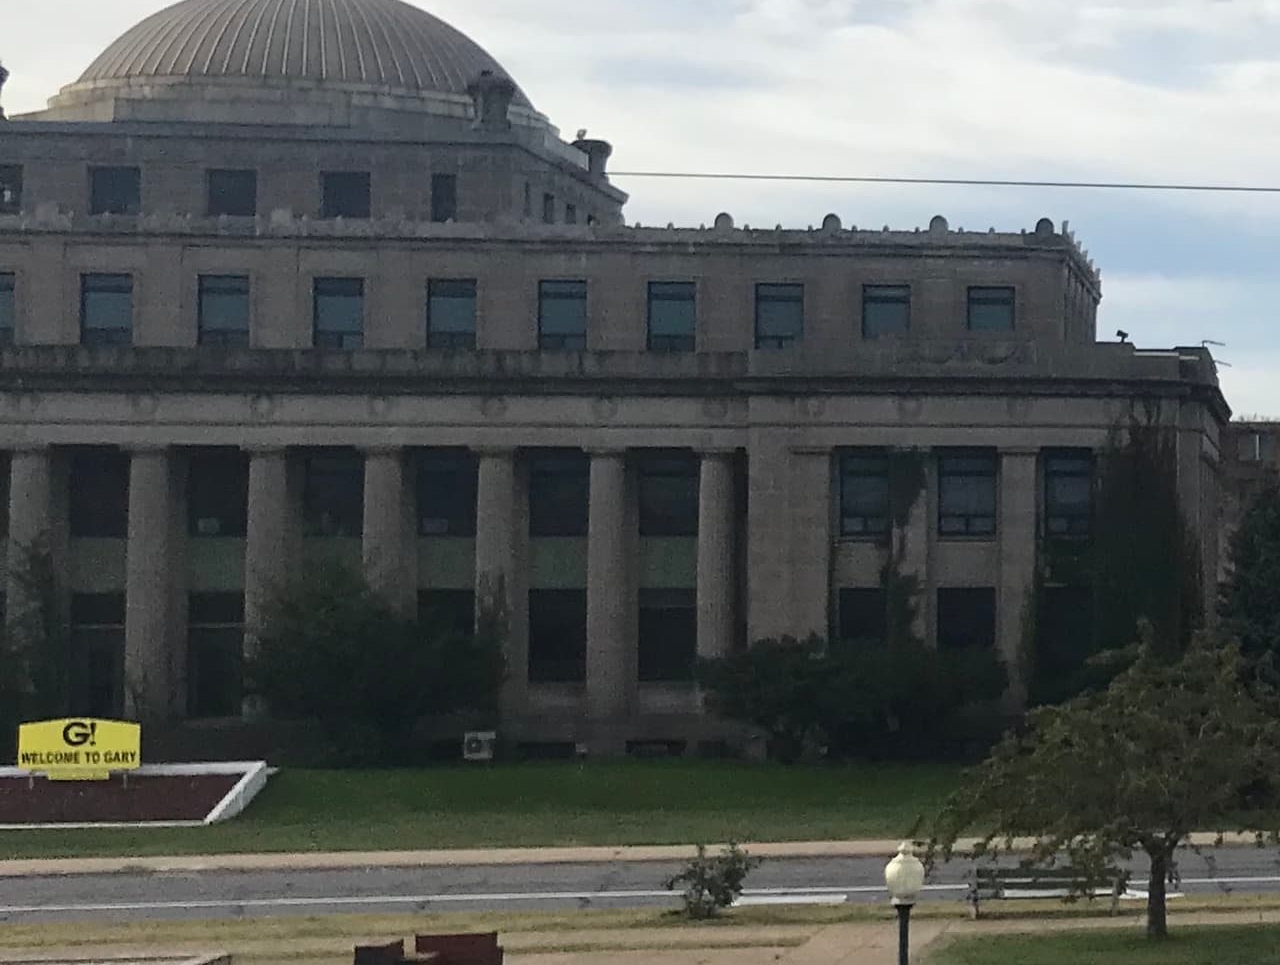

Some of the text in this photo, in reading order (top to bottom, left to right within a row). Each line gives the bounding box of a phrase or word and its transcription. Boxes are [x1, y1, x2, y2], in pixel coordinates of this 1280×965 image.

[62, 722, 97, 747] G!
[21, 750, 137, 765] WELCOME TO GARY
